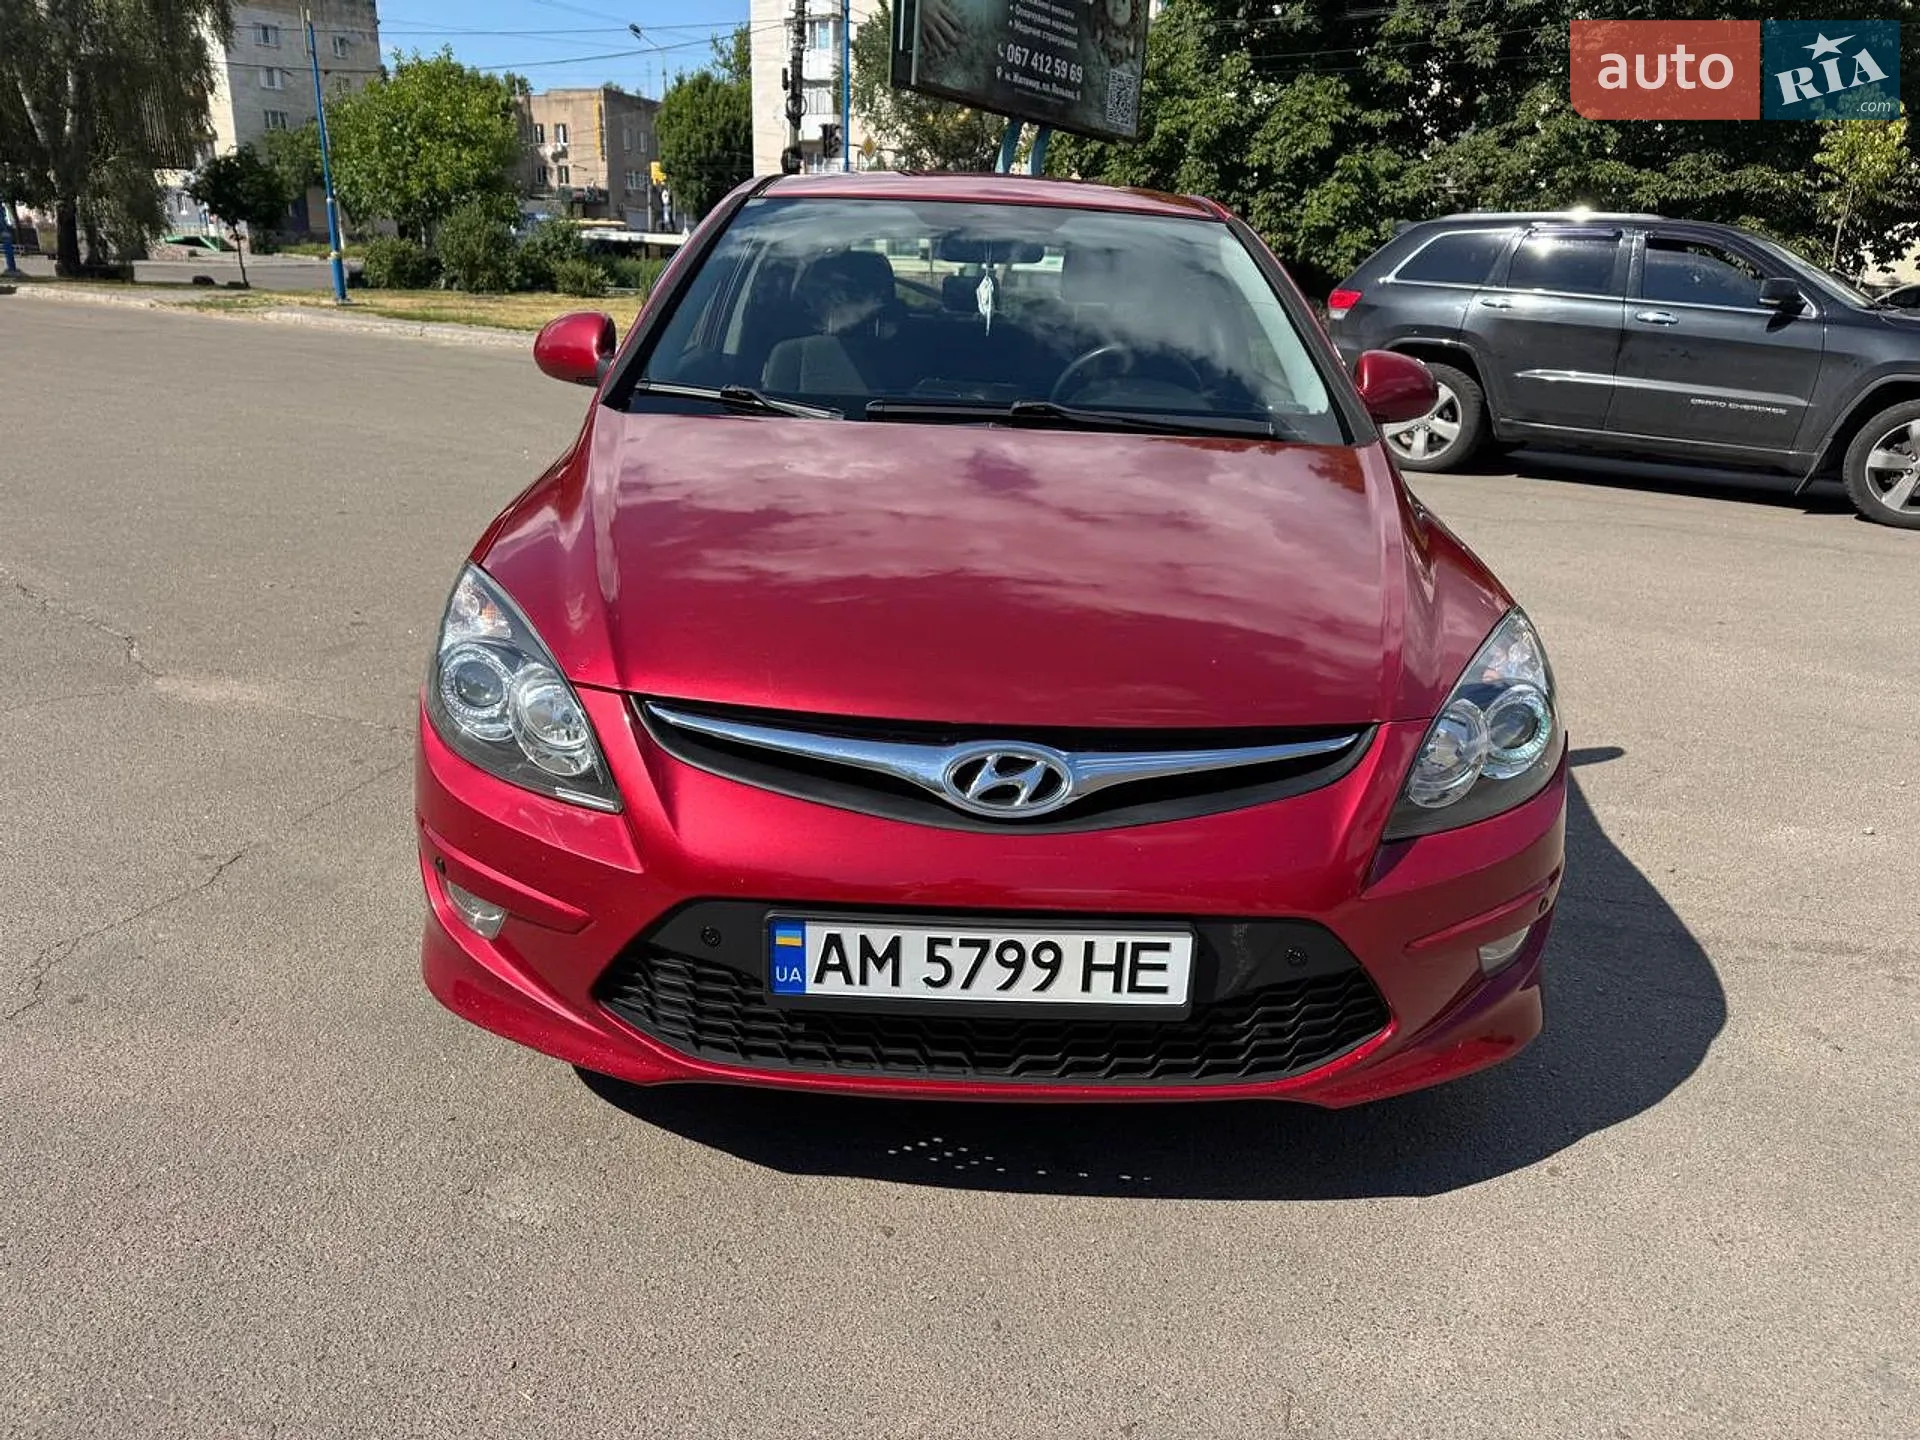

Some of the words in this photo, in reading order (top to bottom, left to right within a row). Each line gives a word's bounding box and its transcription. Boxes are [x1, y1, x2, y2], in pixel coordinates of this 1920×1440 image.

[1006, 43, 1029, 67] 067
[1031, 51, 1052, 74] 412
[1053, 58, 1068, 79] 59
[1069, 63, 1083, 84] 69
[1690, 398, 1727, 408] GRAND
[1728, 402, 1787, 415] CHEROKEE
[775, 966, 802, 983] UA
[812, 932, 901, 988] AM
[922, 936, 1063, 992] 5799
[1080, 940, 1171, 994] HE
